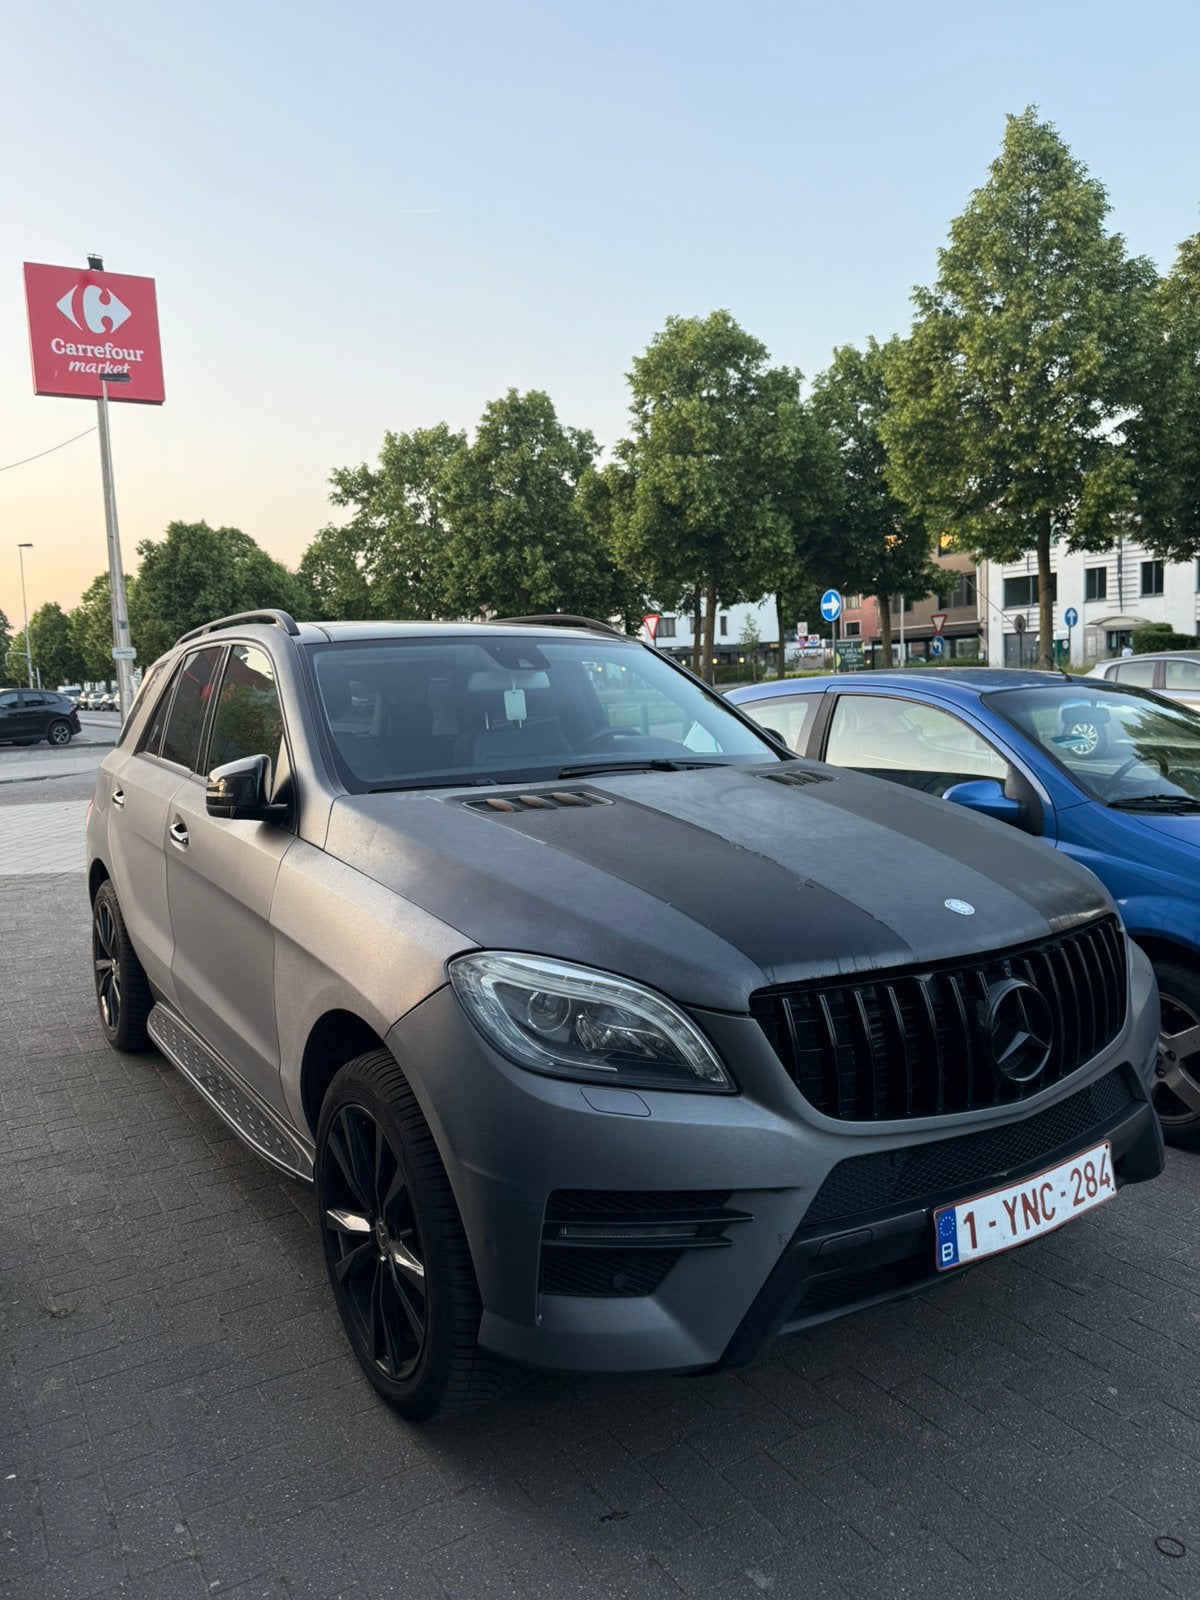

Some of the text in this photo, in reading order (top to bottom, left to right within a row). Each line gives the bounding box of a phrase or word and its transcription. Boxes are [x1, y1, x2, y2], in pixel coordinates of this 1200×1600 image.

[50, 338, 144, 362] Carrefour
[68, 360, 131, 374] market
[964, 1153, 1111, 1250] 1-YNC-284
[941, 1242, 955, 1263] B
